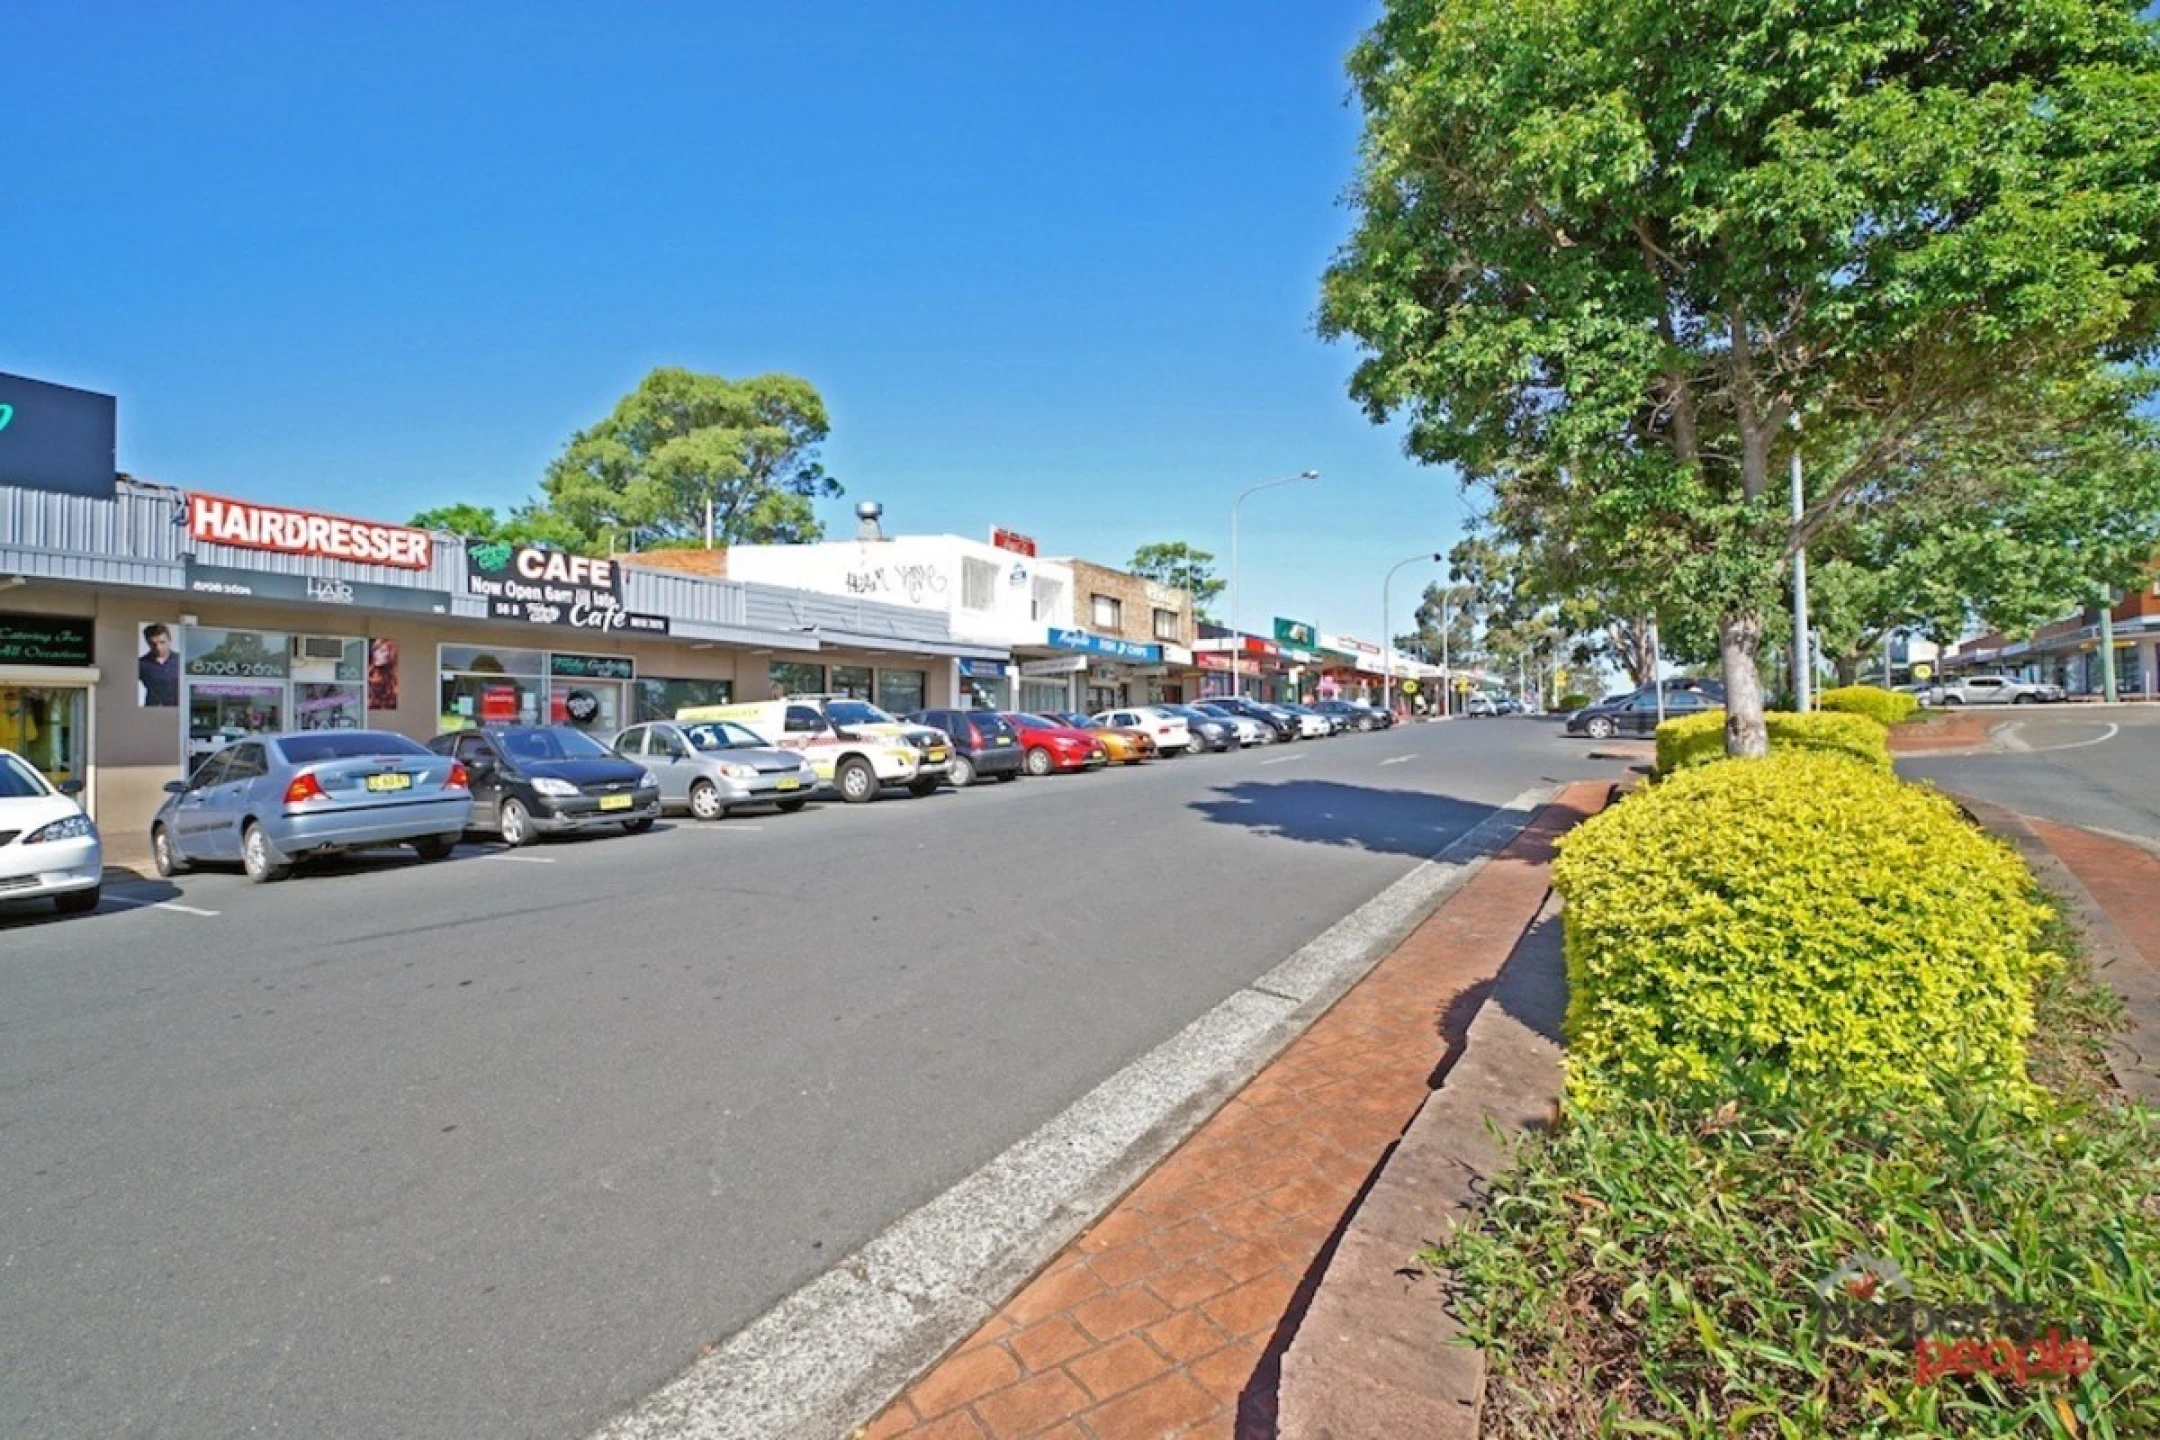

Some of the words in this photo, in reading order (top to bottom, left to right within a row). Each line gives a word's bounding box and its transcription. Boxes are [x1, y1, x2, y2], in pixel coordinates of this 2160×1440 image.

[193, 497, 429, 566] HAIRDRESSER
[516, 547, 613, 588] CAFE
[471, 575, 502, 596] Now
[505, 580, 542, 602] Open
